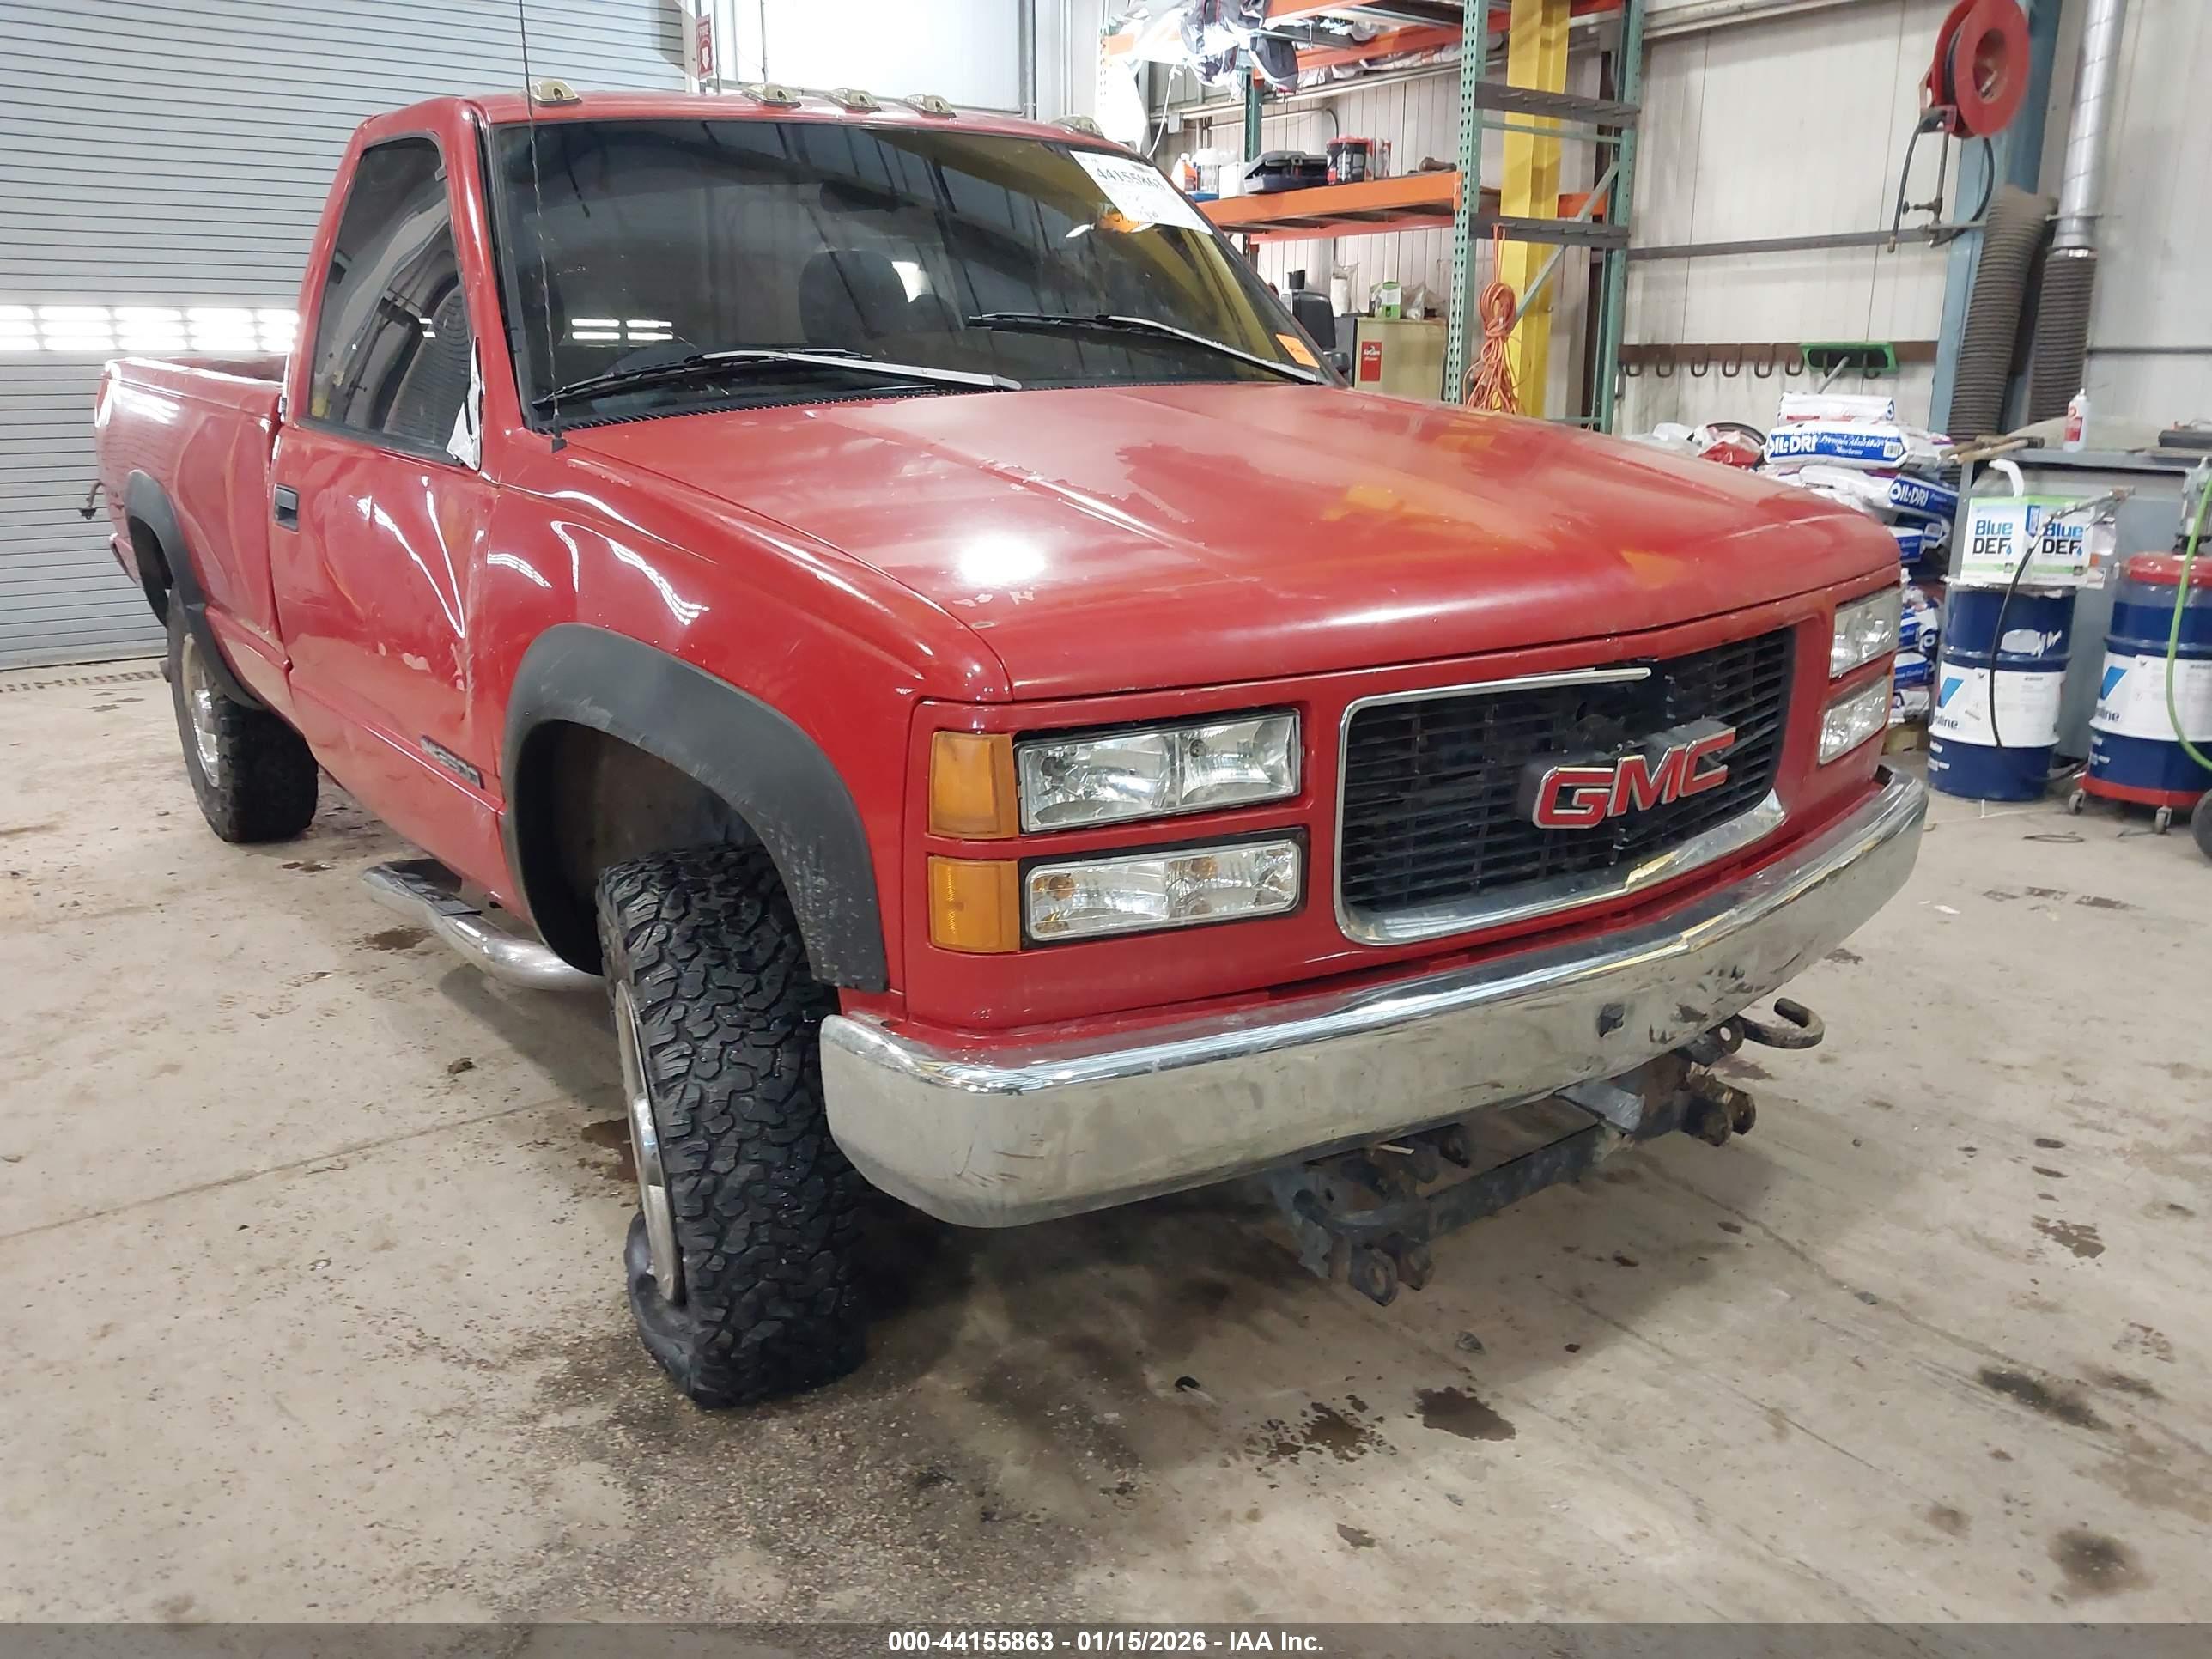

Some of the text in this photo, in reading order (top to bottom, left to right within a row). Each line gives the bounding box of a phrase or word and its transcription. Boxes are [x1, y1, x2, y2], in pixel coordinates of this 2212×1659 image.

[1975, 520, 2014, 536] Blue
[2043, 522, 2084, 538] Blue
[1972, 538, 2011, 555] DEF
[2042, 538, 2082, 555] DEF
[1532, 727, 1736, 830] GMC
